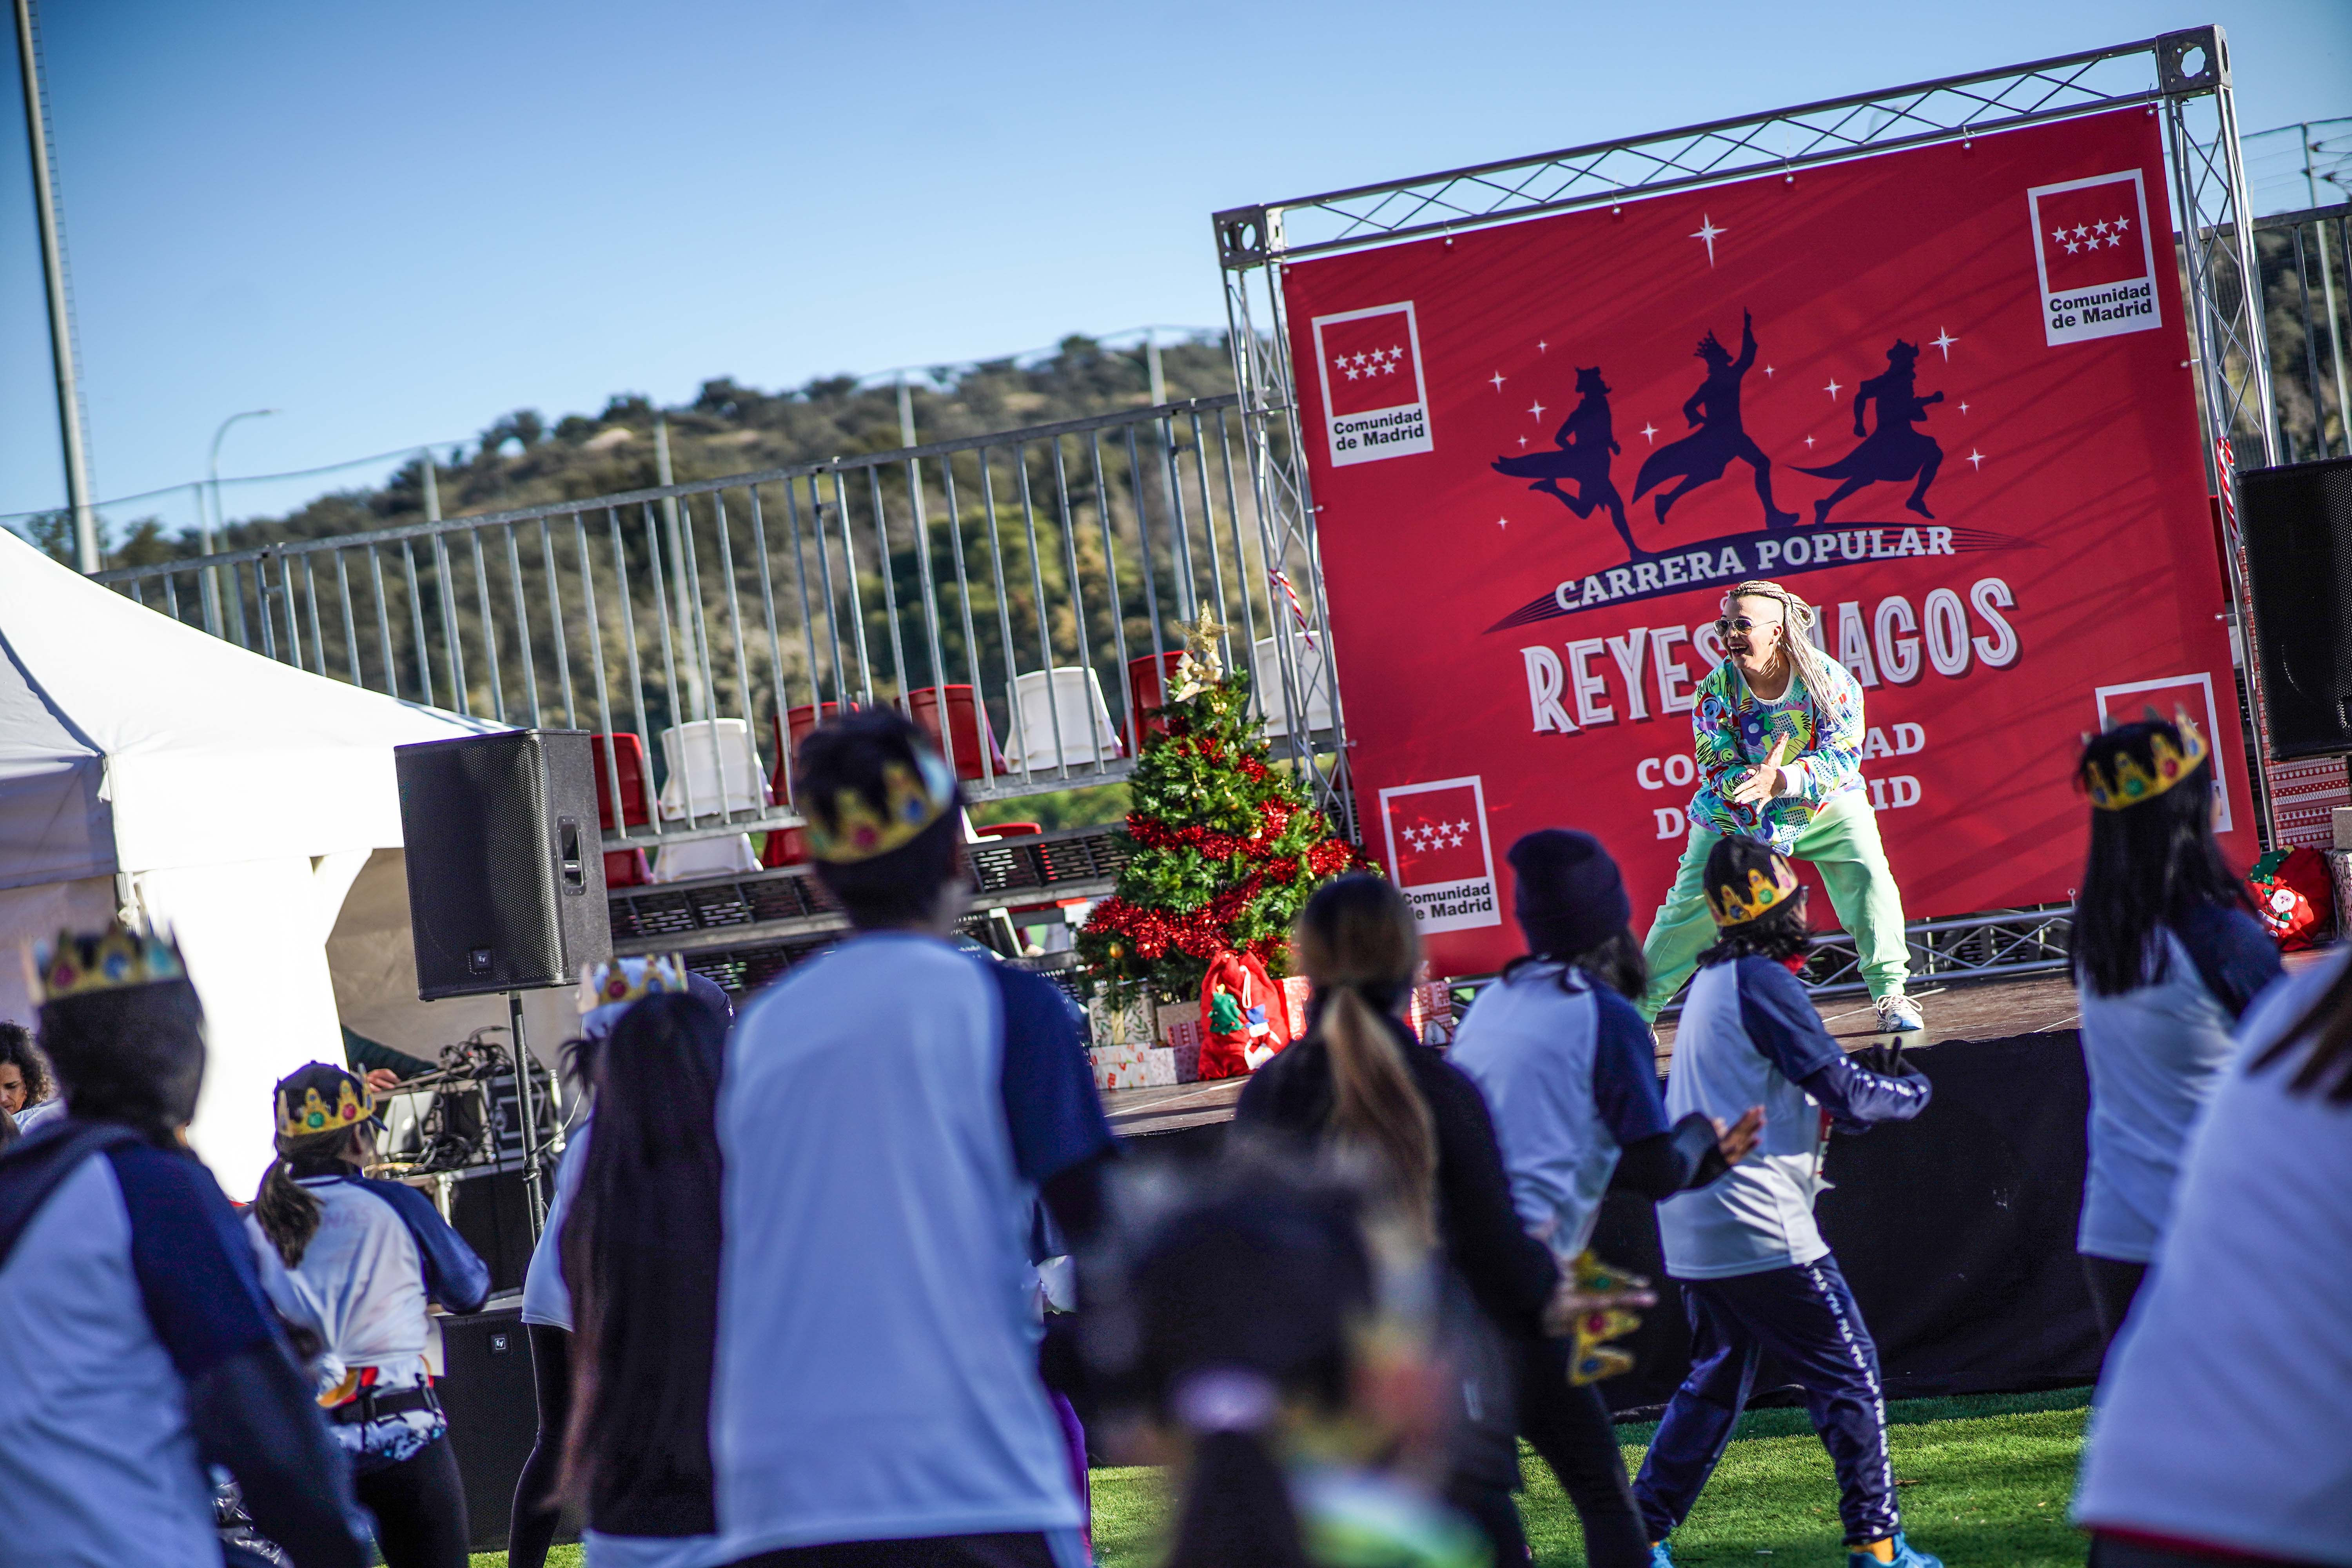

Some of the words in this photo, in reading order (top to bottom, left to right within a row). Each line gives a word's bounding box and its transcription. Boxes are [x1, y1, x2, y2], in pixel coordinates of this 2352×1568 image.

[2049, 282, 2151, 312] Comunidad
[2051, 314, 2076, 329] de
[2082, 298, 2152, 324] Madrid
[1334, 408, 1423, 435] Comunidad
[1336, 436, 1357, 451] de
[1363, 423, 1425, 446] Madrid
[1555, 546, 1746, 610] CARRERA
[1756, 526, 1955, 569] POPULAR
[1808, 577, 2017, 687] AGOS
[1430, 897, 1493, 918] Madrid
